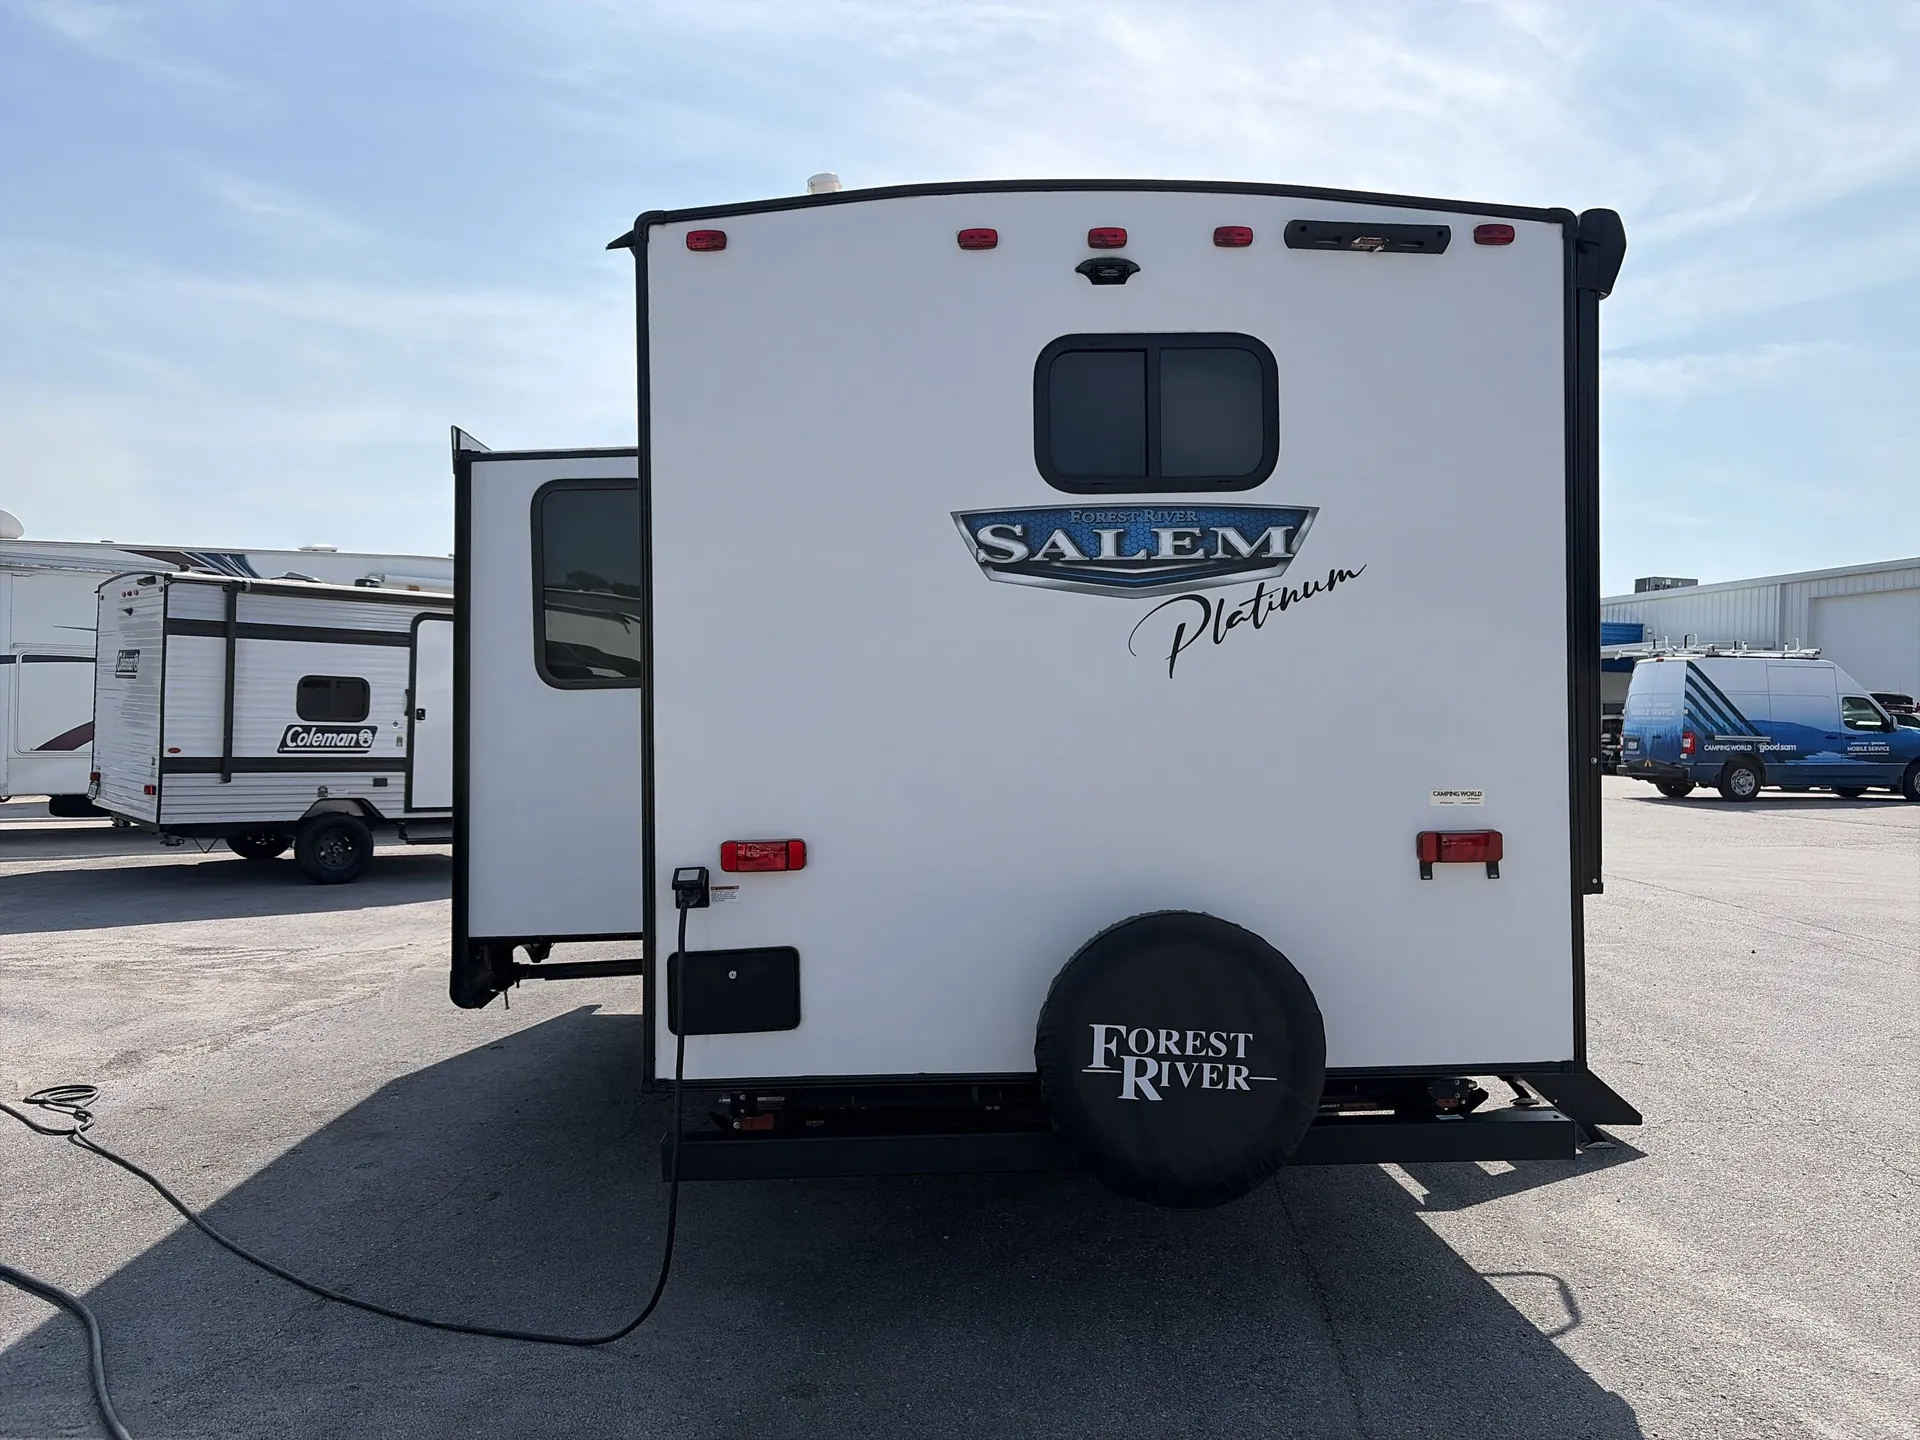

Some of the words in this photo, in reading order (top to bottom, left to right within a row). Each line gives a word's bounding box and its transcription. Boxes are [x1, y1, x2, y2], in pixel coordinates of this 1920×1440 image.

[1069, 509, 1138, 523] FOREST
[1142, 509, 1198, 522] RIVER
[977, 523, 1294, 563] SALEM
[1128, 563, 1367, 679] Platinum
[286, 726, 357, 747] Coleman
[1087, 1023, 1253, 1069] FOREST
[1118, 1055, 1251, 1101] RIVER
